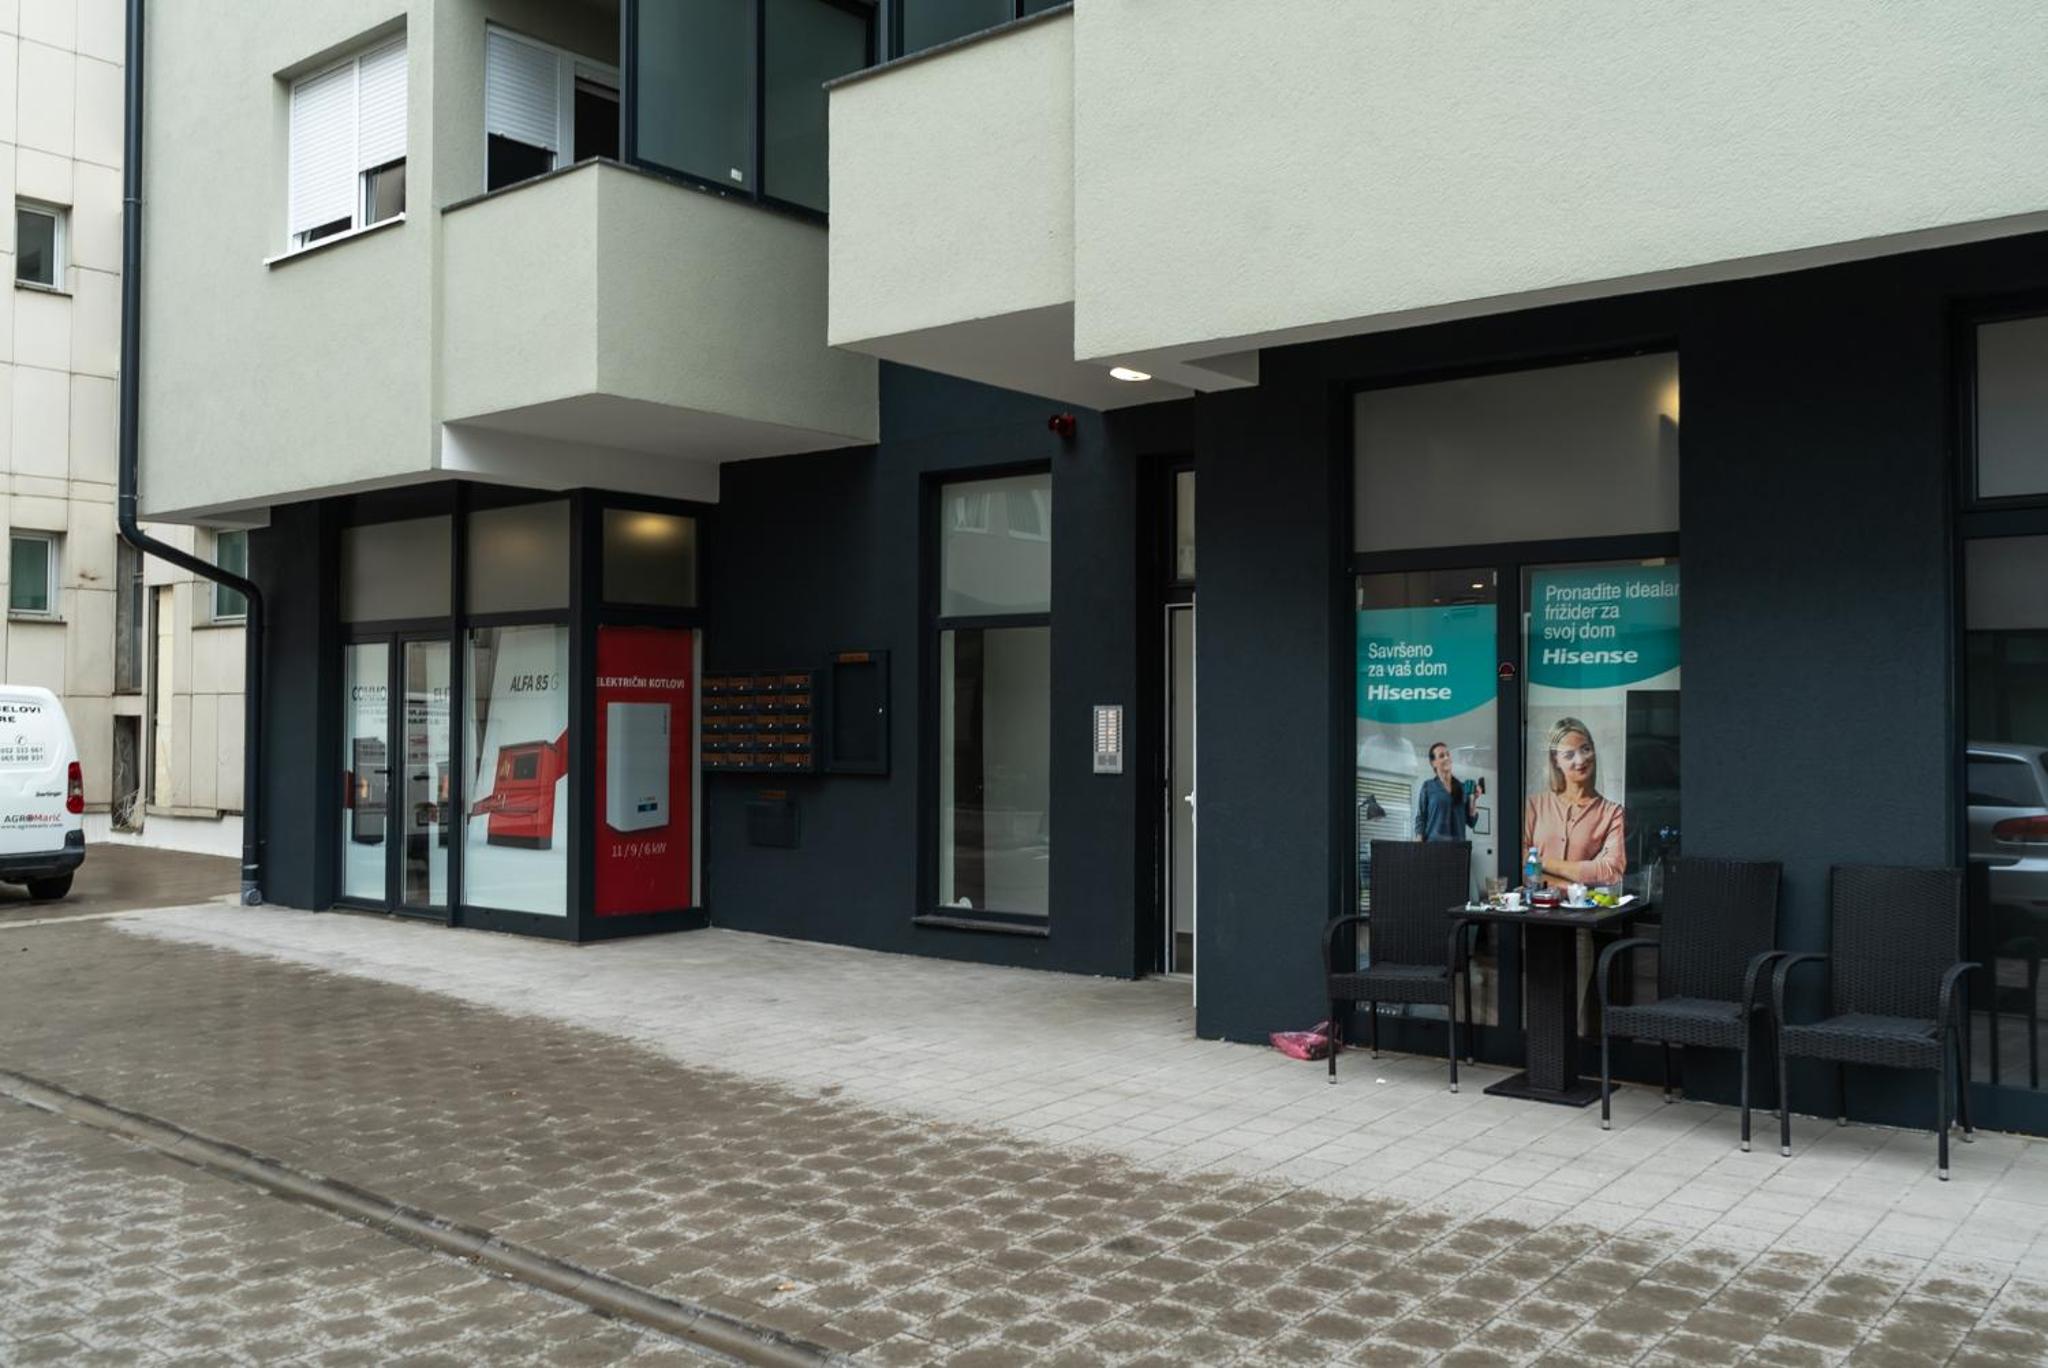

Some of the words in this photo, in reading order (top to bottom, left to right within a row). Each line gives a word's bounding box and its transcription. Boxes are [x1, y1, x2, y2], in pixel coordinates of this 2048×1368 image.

[1601, 605, 1620, 619] za
[1544, 622, 1576, 643] svoj
[1579, 622, 1616, 638] dom
[1368, 642, 1433, 659] Savršeno
[1542, 648, 1639, 665] Hisense
[1368, 664, 1385, 677] za
[1388, 661, 1412, 677] vaš
[1415, 660, 1447, 676] dom
[510, 674, 533, 691] ALFA
[535, 674, 549, 691] 85
[649, 677, 685, 689] KOTLOVI
[1367, 684, 1452, 700] Hisense
[0, 705, 41, 714] ELOVI
